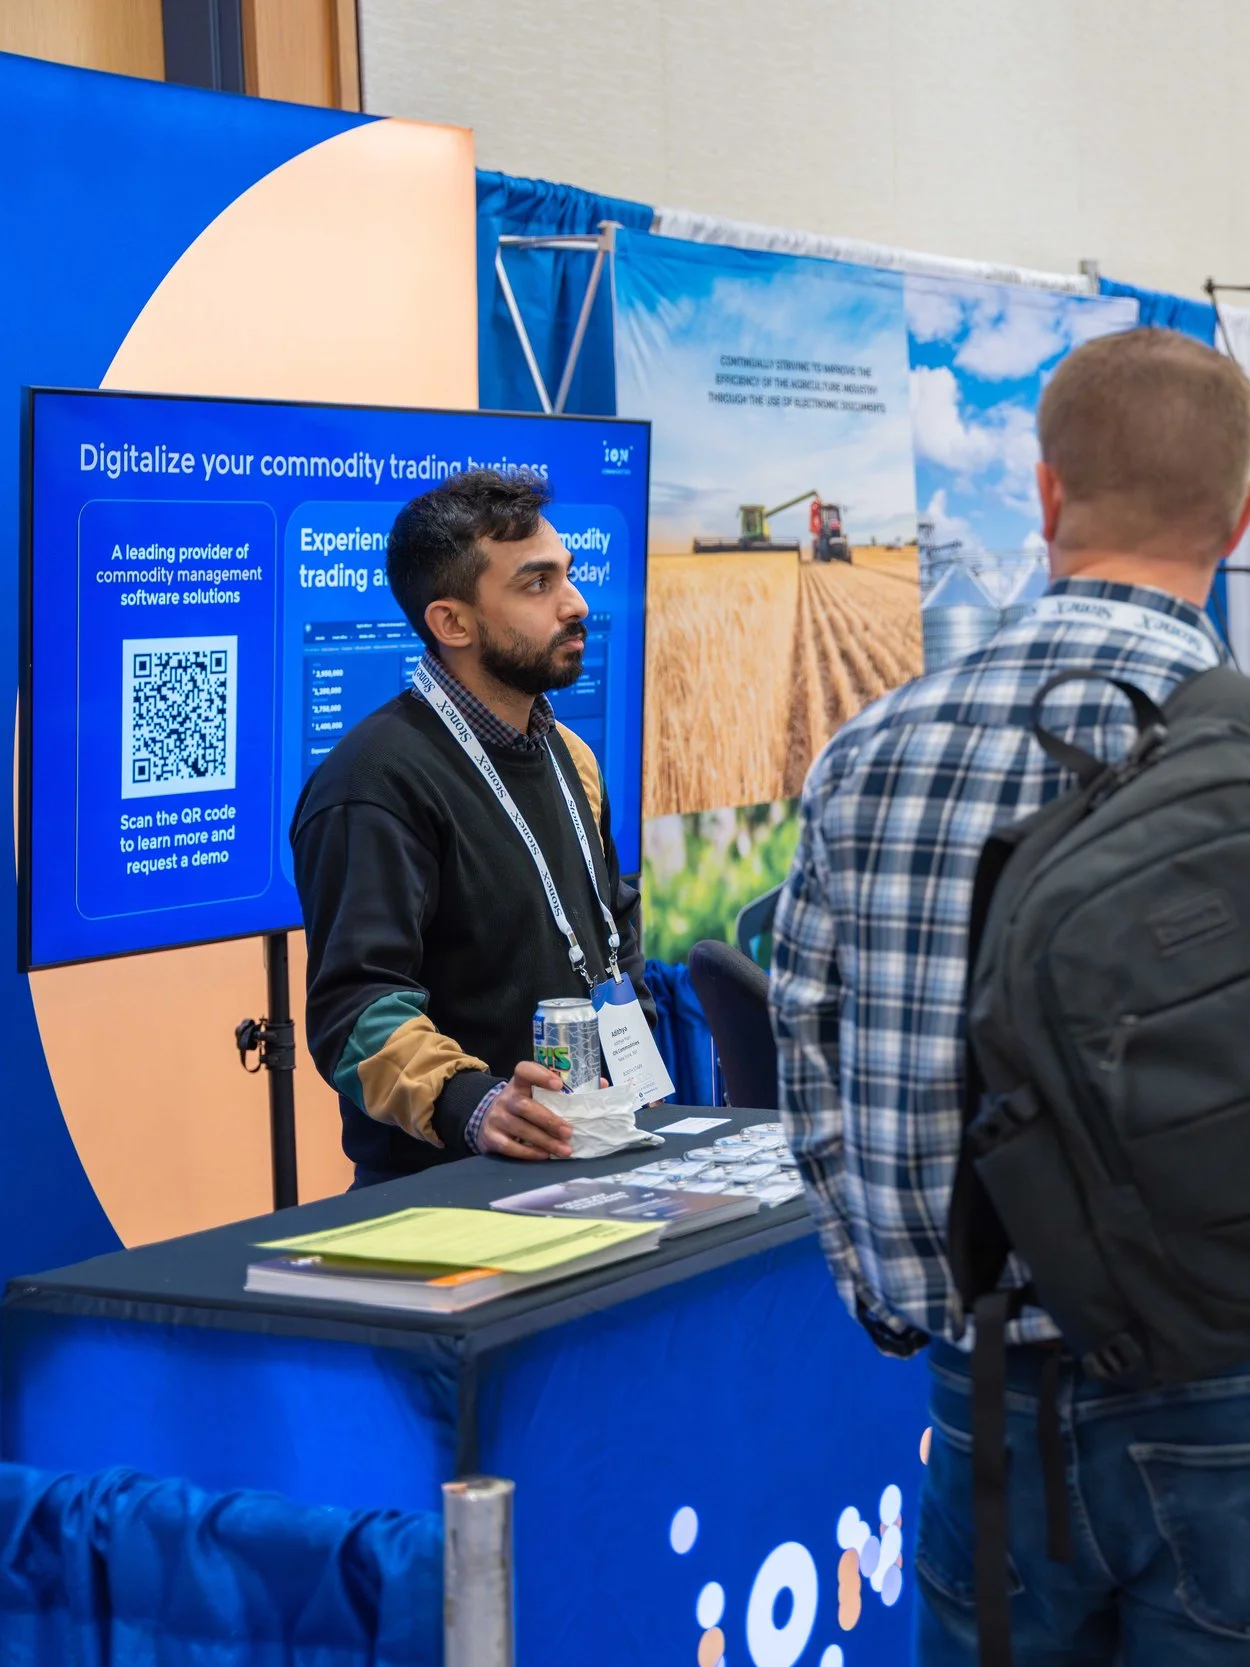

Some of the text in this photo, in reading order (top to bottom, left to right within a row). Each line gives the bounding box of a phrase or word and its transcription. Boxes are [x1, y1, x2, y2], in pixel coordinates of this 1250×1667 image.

[762, 376, 772, 388] OF
[774, 377, 789, 389] THE
[812, 361, 822, 374] TO
[858, 366, 872, 378] THE
[749, 394, 764, 407] THE
[767, 395, 781, 408] USE
[783, 396, 793, 409] OF
[80, 442, 195, 479] Digitalize
[202, 454, 254, 481] your
[260, 452, 385, 485] commodity
[111, 543, 250, 563] A leading provider of
[96, 566, 262, 585] commodity management
[299, 562, 368, 592] trading
[121, 588, 240, 606] software solutions
[437, 700, 472, 743] StoneX
[475, 754, 507, 798] StoneX
[120, 804, 236, 830] Scan the QR code
[568, 799, 588, 845] StoneX
[120, 825, 235, 852] to learn more and
[511, 811, 540, 856] StoneX
[127, 850, 229, 876] request a demo
[541, 870, 562, 917] StoneX
